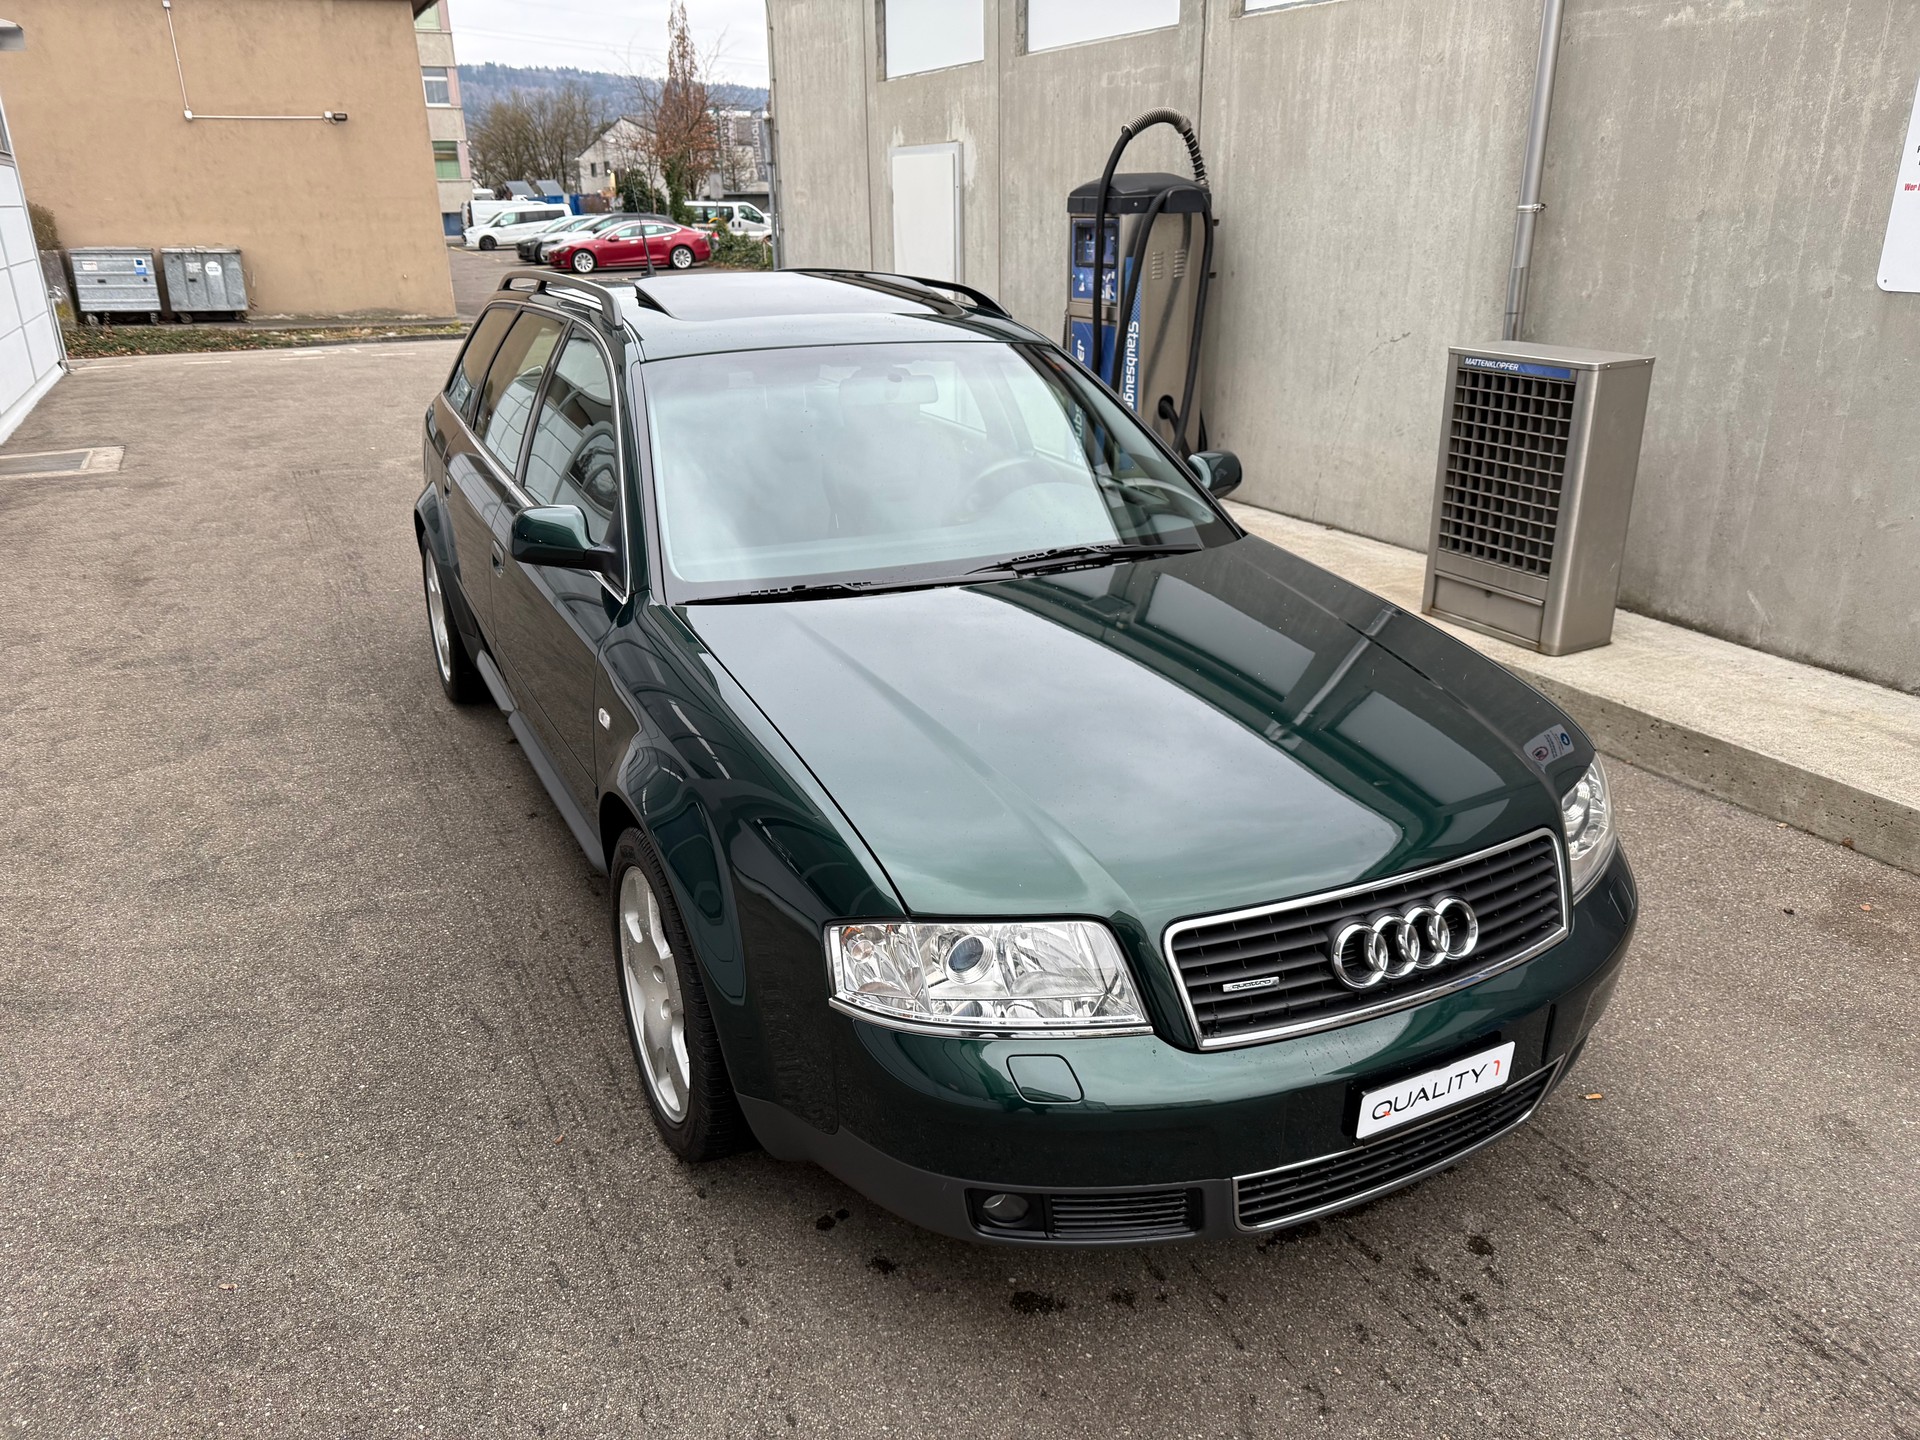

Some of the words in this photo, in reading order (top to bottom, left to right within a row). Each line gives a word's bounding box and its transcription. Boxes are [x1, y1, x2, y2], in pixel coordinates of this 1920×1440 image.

[1464, 357, 1519, 371] MATTENKLOPFER
[1232, 980, 1271, 989] quattro
[1371, 1063, 1488, 1121] QUALITY
[1493, 1059, 1501, 1076] 1
